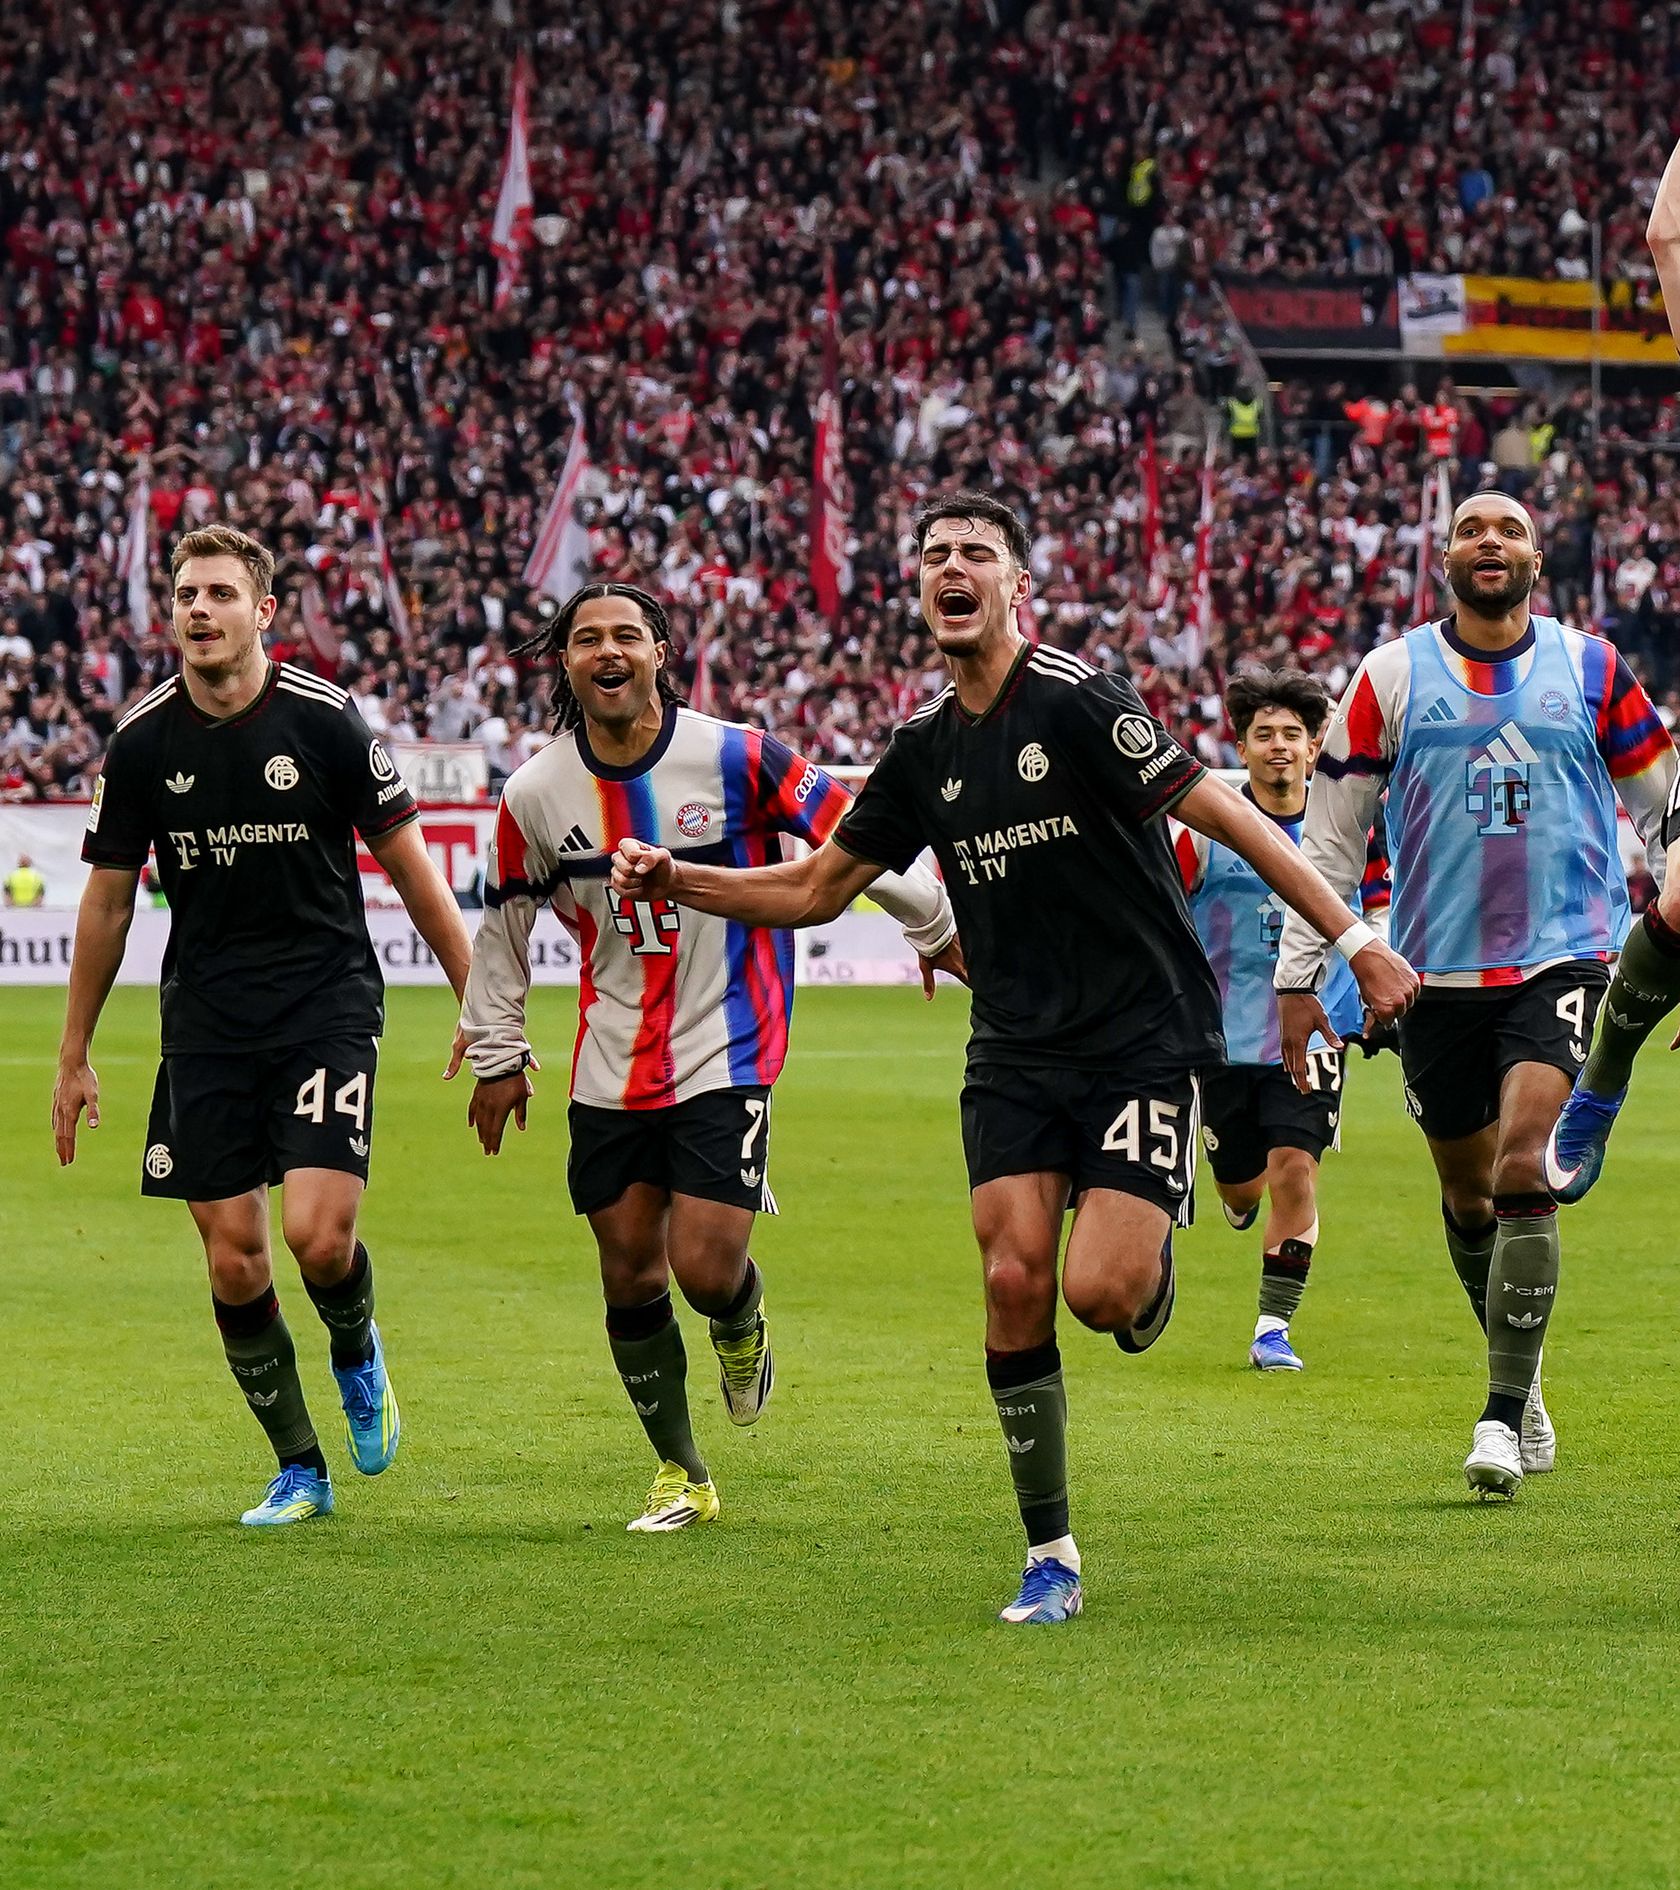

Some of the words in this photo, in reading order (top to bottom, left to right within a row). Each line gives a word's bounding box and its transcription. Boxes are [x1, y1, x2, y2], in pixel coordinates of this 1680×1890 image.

[1137, 744, 1182, 785] Allianz
[168, 831, 200, 870] T
[206, 823, 310, 846] MAGENTA
[210, 847, 236, 866] TV
[953, 840, 979, 885] T
[974, 816, 1079, 857] MAGENTA
[980, 856, 1006, 881] TV
[1556, 986, 1586, 1039] 4
[293, 1068, 367, 1130] 44
[745, 1099, 765, 1159] 7
[1101, 1099, 1180, 1170] 45
[1503, 1282, 1554, 1297] FCBM
[231, 1358, 278, 1376] CBM
